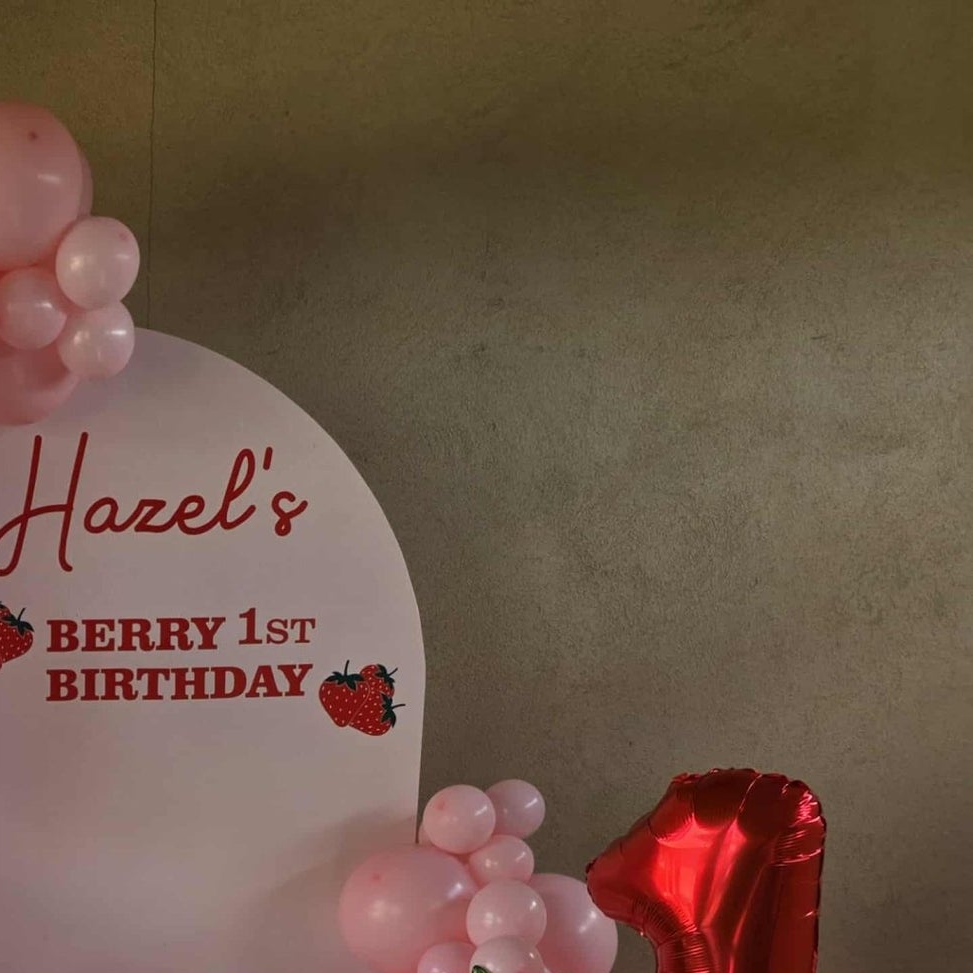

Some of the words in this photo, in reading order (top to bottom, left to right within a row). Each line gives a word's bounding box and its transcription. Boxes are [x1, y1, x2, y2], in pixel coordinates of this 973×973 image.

[46, 616, 226, 653] BERRY
[238, 607, 317, 646] 1ST
[46, 663, 314, 702] BIRTHDAY
